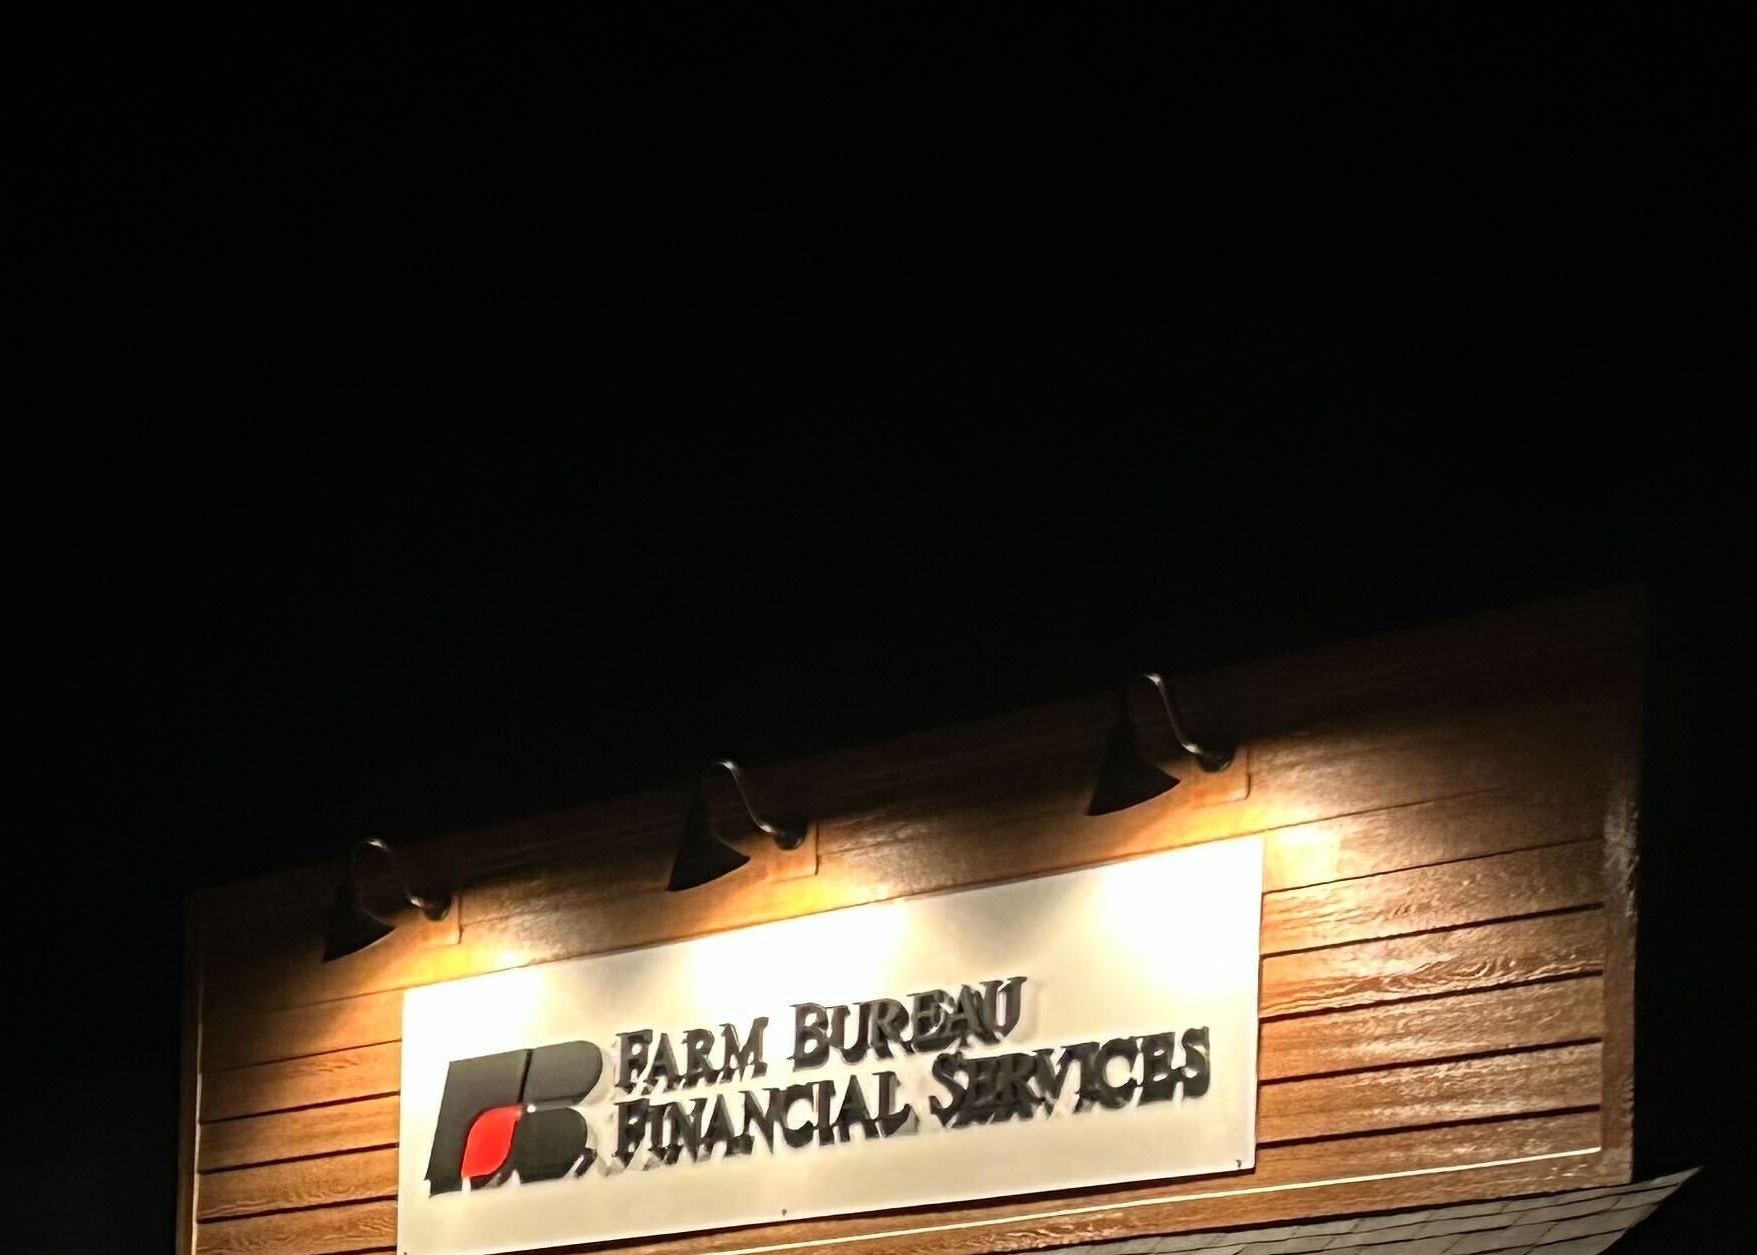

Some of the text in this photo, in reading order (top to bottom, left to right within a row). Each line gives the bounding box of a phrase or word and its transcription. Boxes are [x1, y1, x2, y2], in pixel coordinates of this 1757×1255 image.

[612, 1026, 1211, 1164] FINANCIAL SERVICES
[614, 976, 1028, 1091] FARM BUREAU
